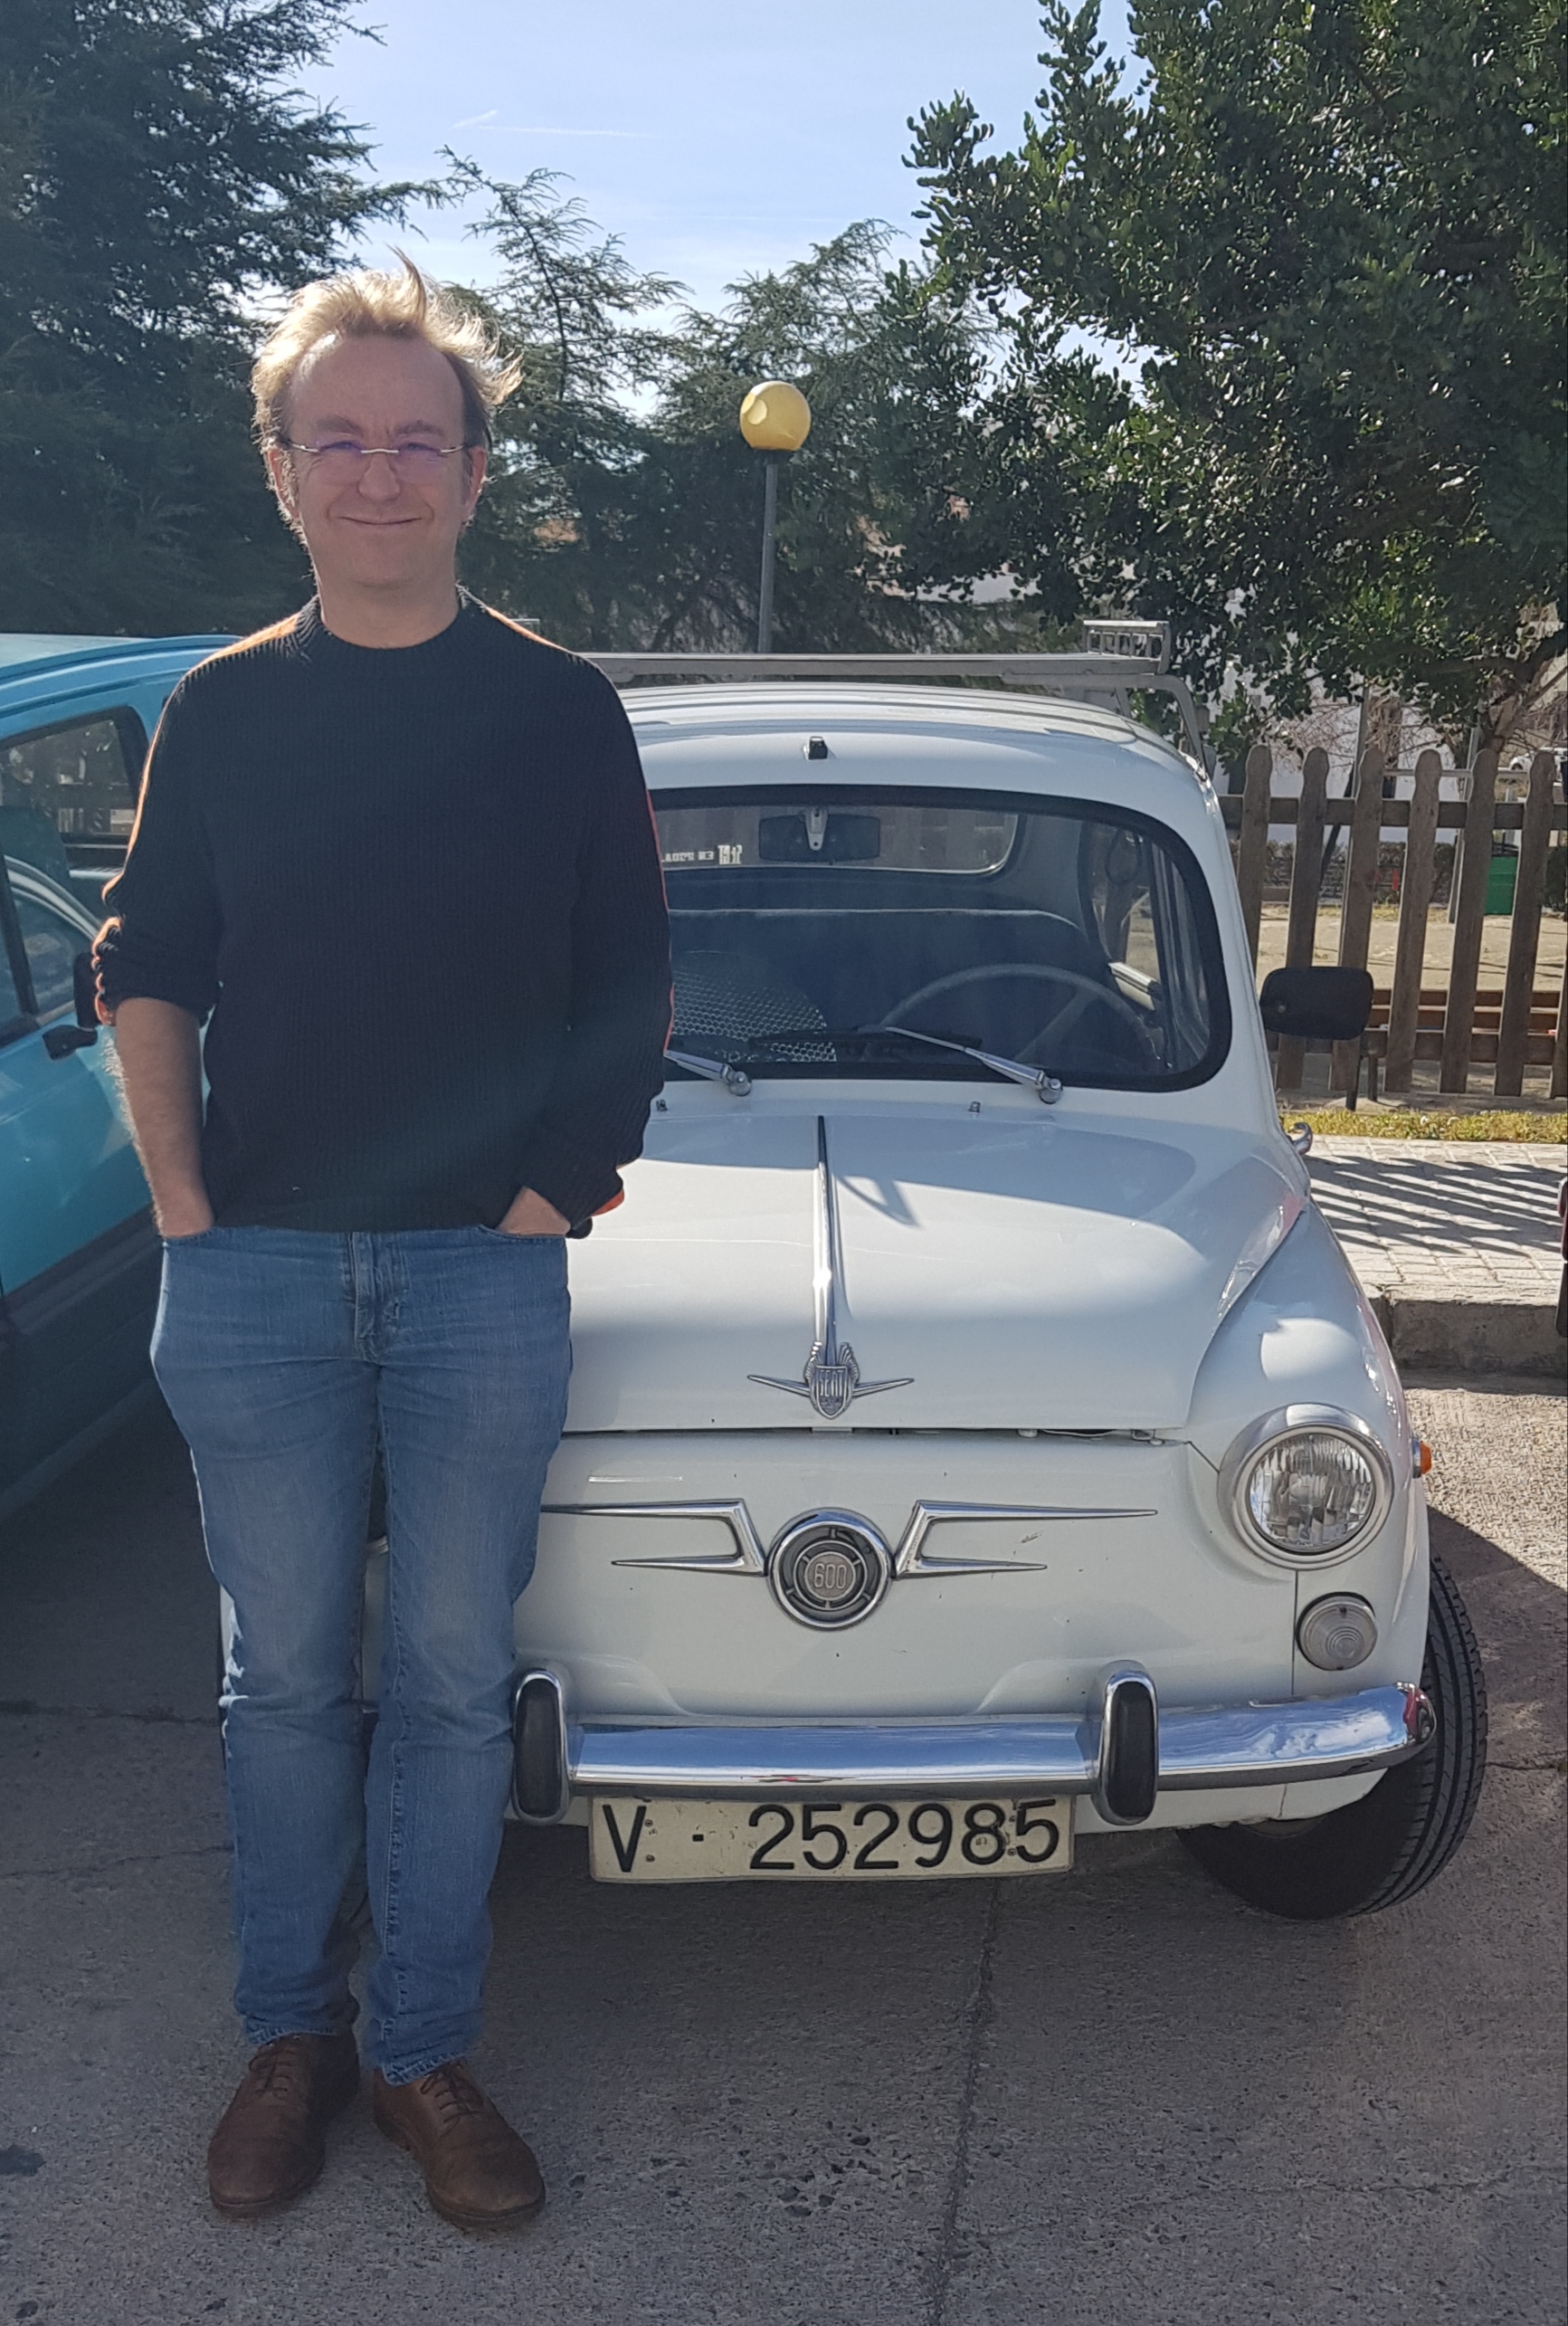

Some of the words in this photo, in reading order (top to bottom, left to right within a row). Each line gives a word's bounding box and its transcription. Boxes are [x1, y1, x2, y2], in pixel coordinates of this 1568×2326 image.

[820, 1369, 844, 1397] SEAT
[814, 1563, 847, 1589] 600
[602, 1804, 648, 1873] V
[748, 1798, 1060, 1870] 252985
